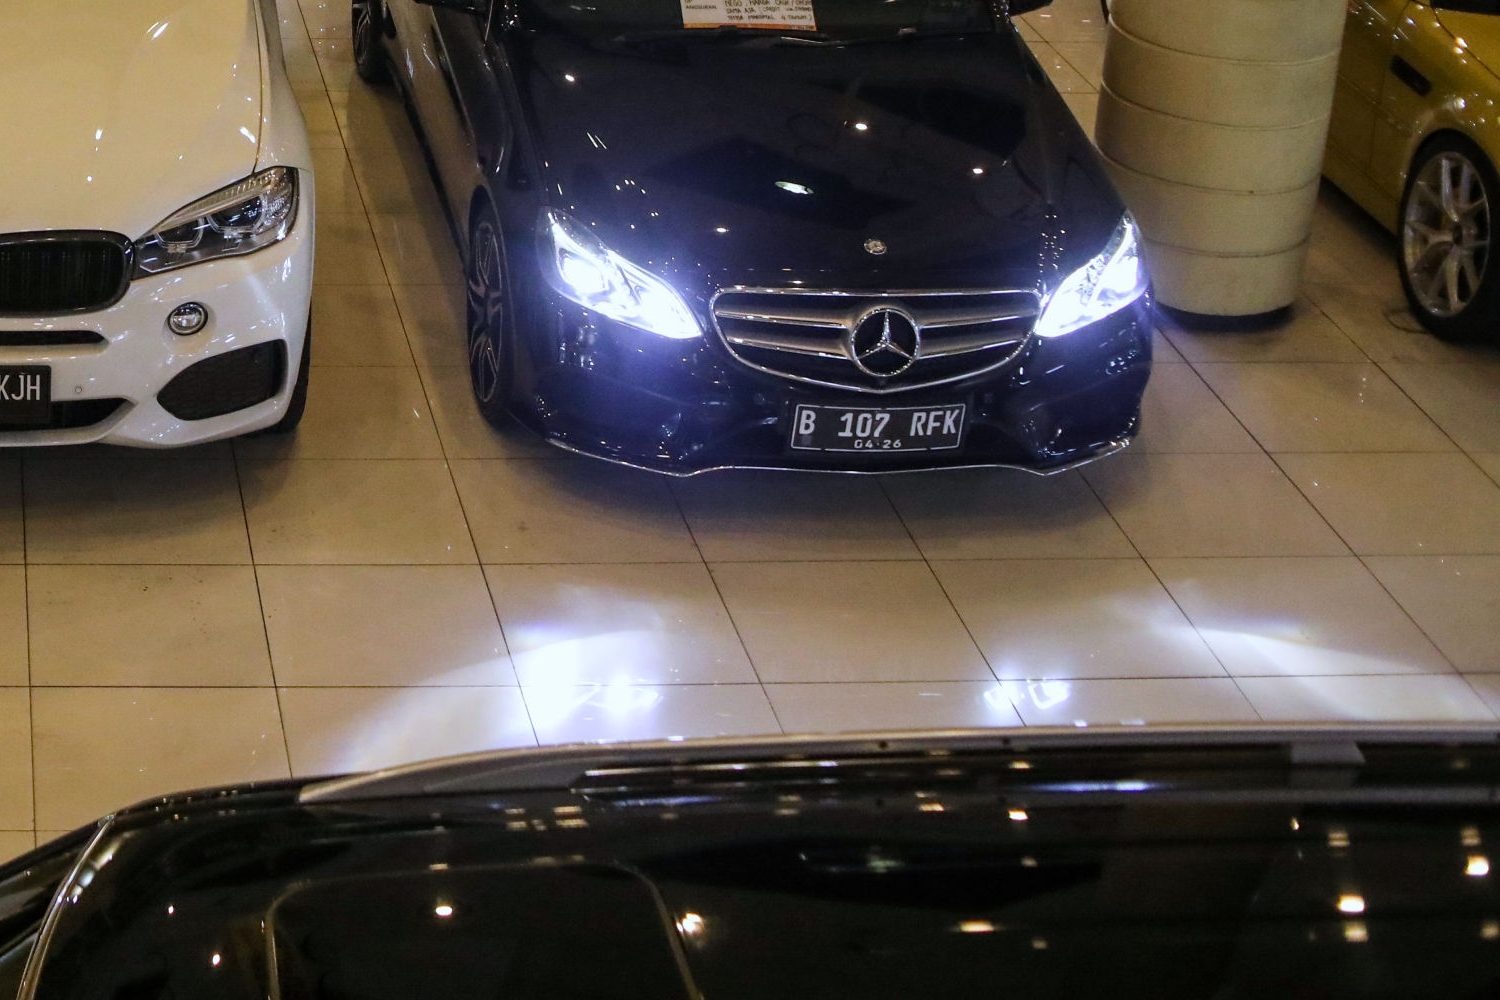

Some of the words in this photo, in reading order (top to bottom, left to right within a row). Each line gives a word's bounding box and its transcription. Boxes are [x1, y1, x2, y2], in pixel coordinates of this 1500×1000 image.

[799, 410, 816, 435] B
[838, 412, 891, 437] 107
[910, 409, 960, 437] RFK
